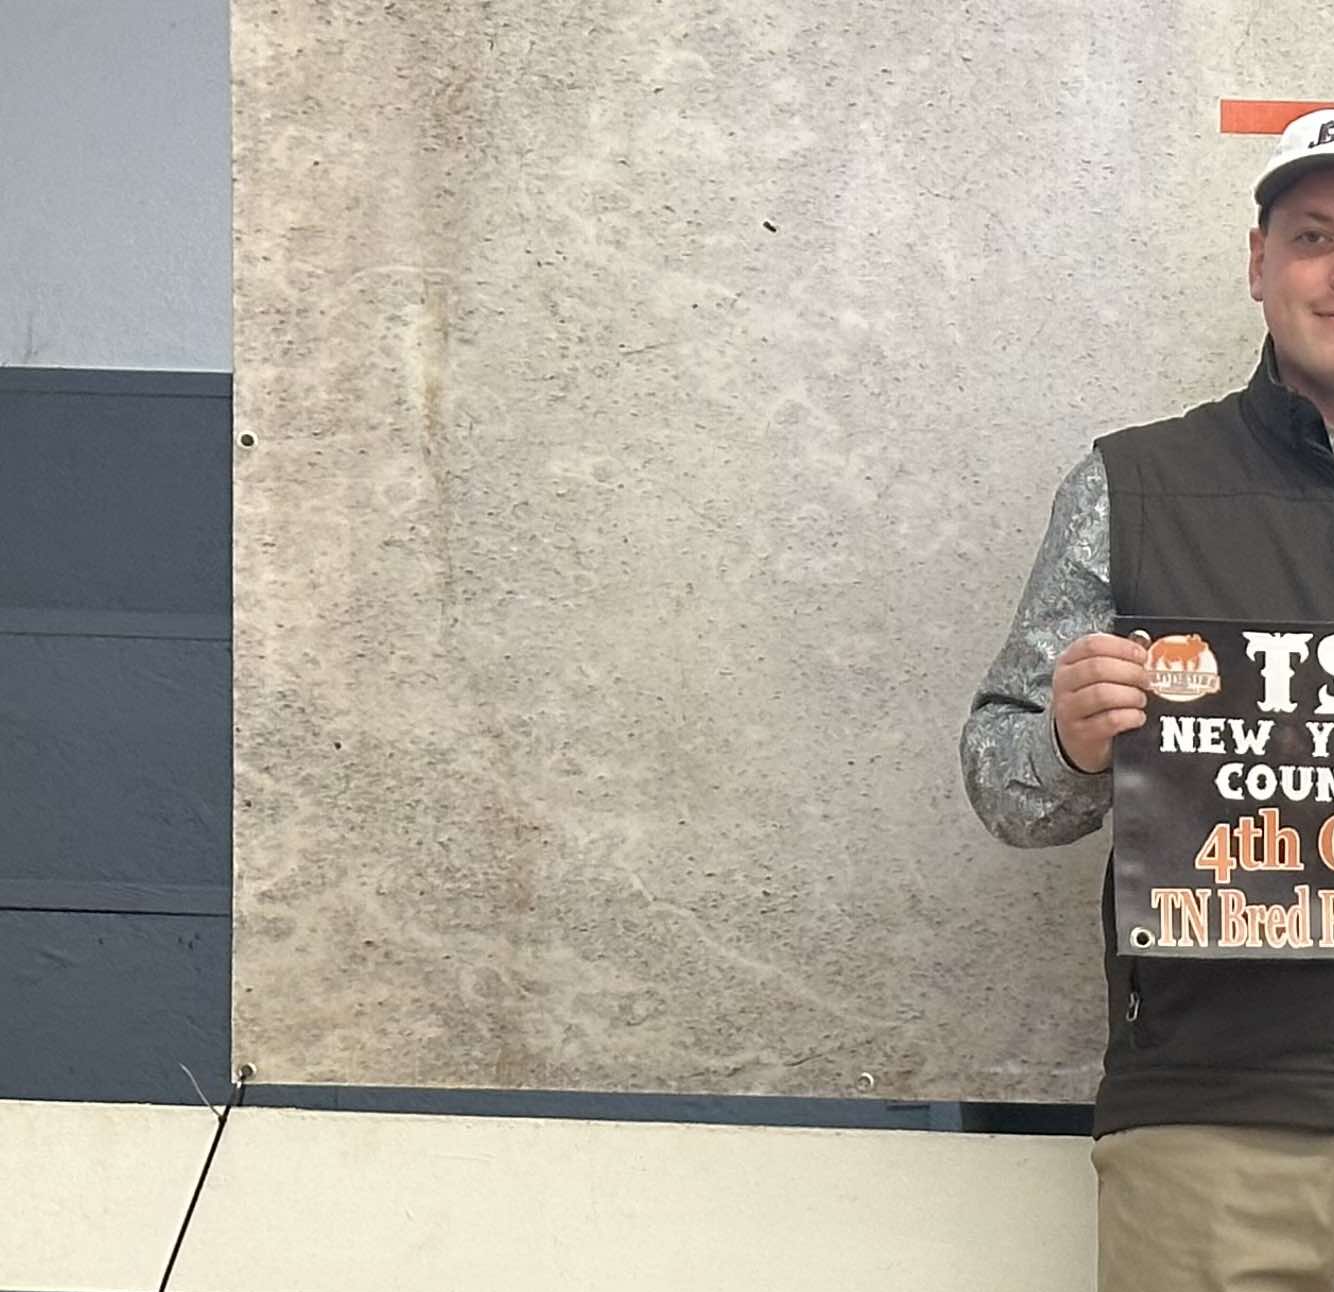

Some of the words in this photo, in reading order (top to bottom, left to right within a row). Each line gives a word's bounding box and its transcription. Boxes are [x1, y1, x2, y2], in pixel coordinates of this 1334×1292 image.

[1159, 715, 1275, 756] NEW
[1195, 807, 1304, 884] 4th
[1151, 888, 1211, 948] TN
[1217, 884, 1313, 949] Bred
